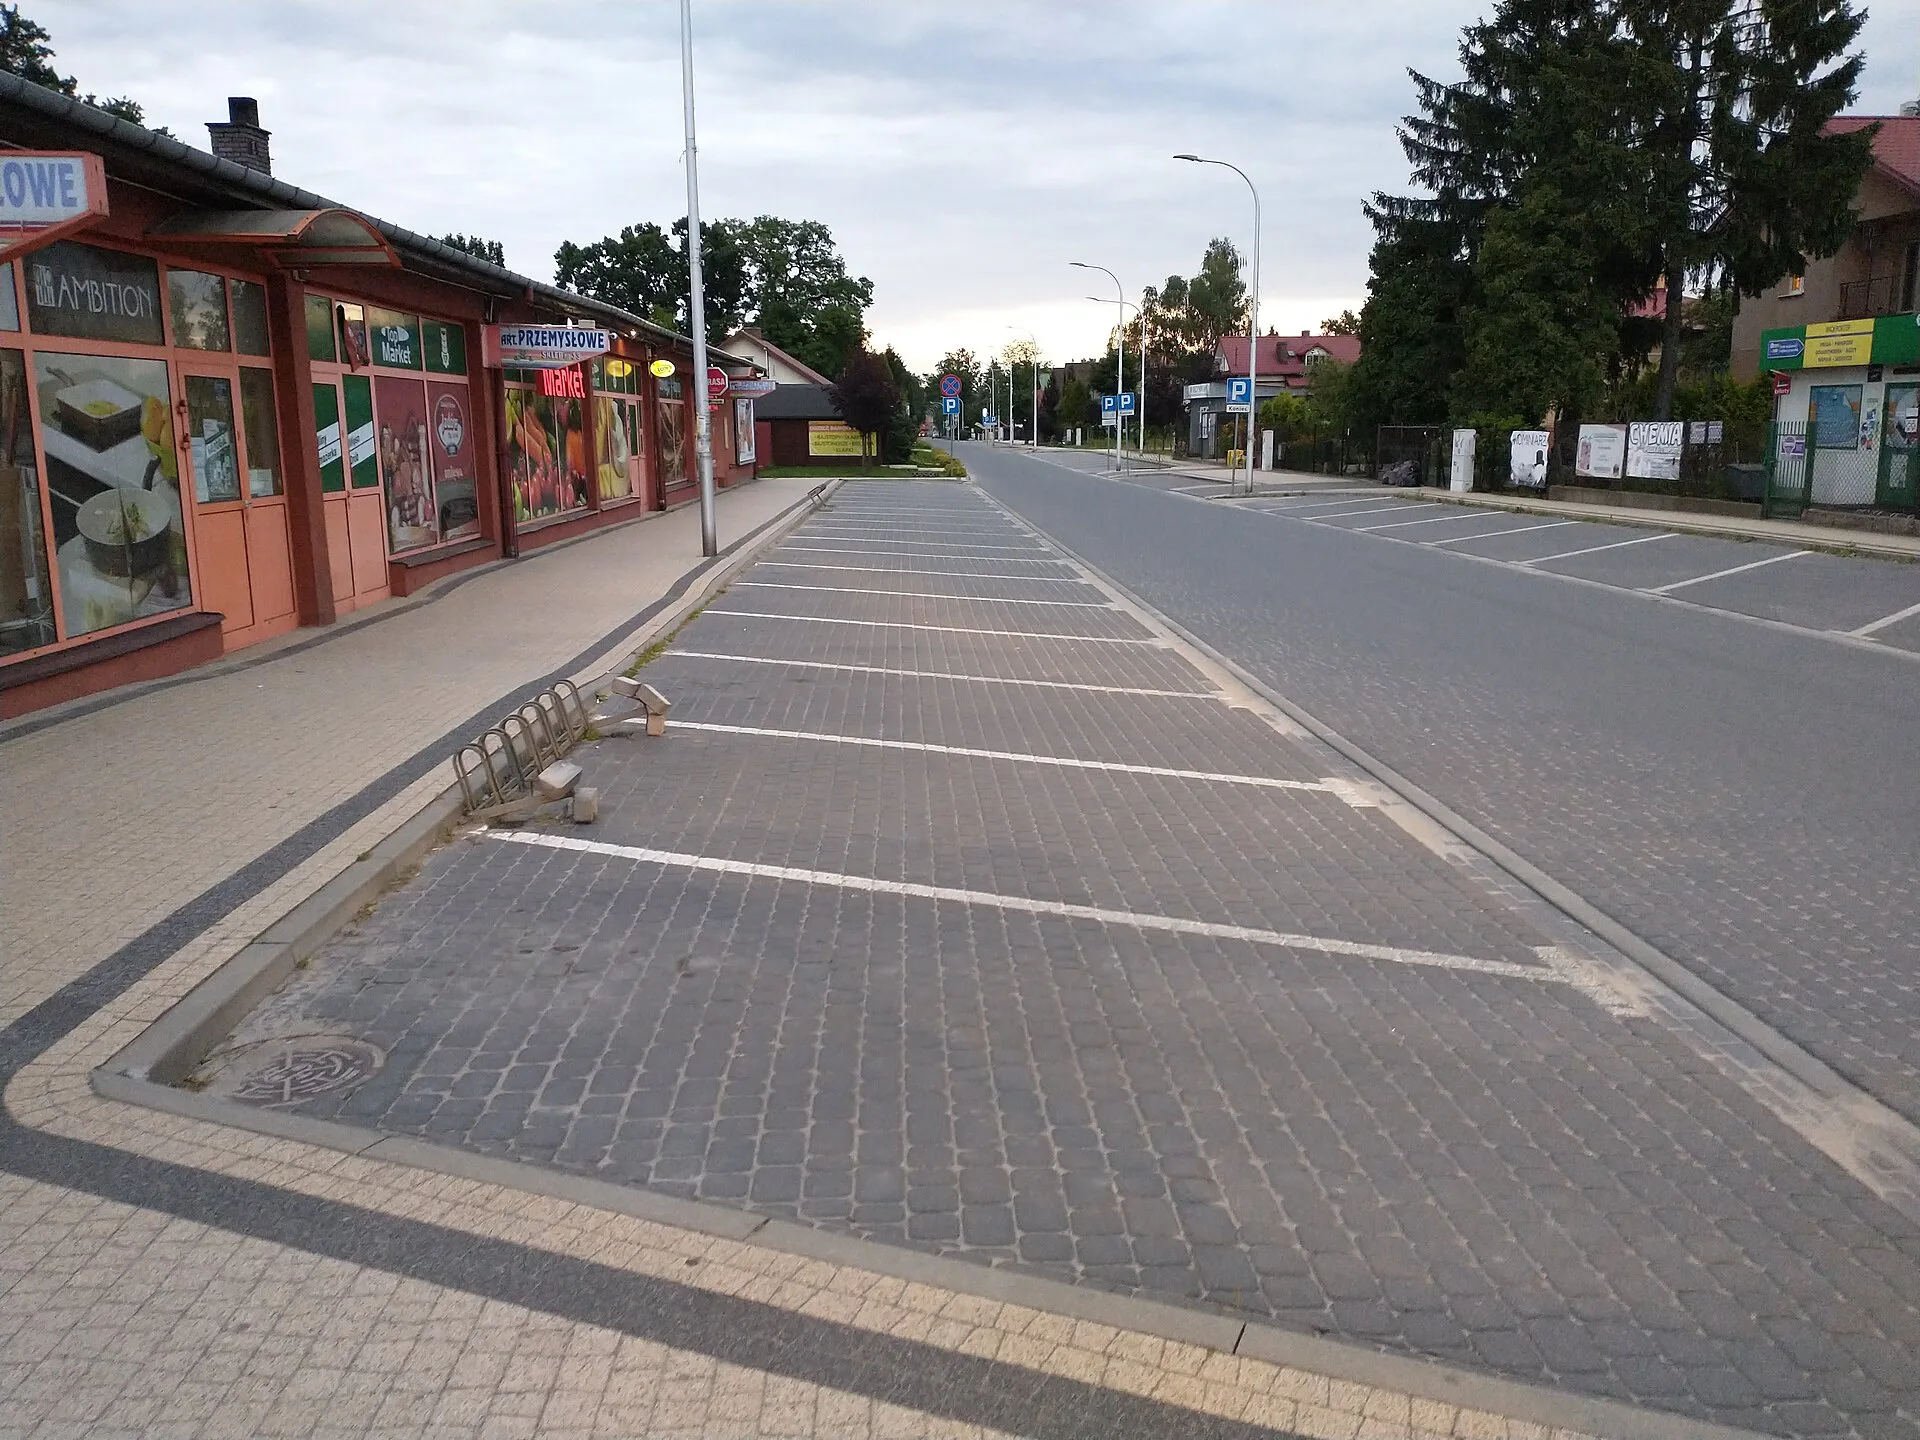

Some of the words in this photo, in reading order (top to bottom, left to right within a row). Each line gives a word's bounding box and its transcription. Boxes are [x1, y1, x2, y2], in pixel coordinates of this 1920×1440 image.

[0, 162, 78, 208] OWE
[58, 274, 153, 319] AMBITION
[384, 326, 399, 346] Top
[518, 329, 605, 349] PRZEMYSŁOWE
[381, 341, 412, 364] Market
[542, 362, 586, 399] Market
[708, 377, 726, 386] RASA
[1231, 380, 1247, 401] P
[946, 398, 956, 413] P
[1104, 397, 1114, 410] P
[1120, 394, 1131, 409] P
[1629, 422, 1683, 446] CHEMIA
